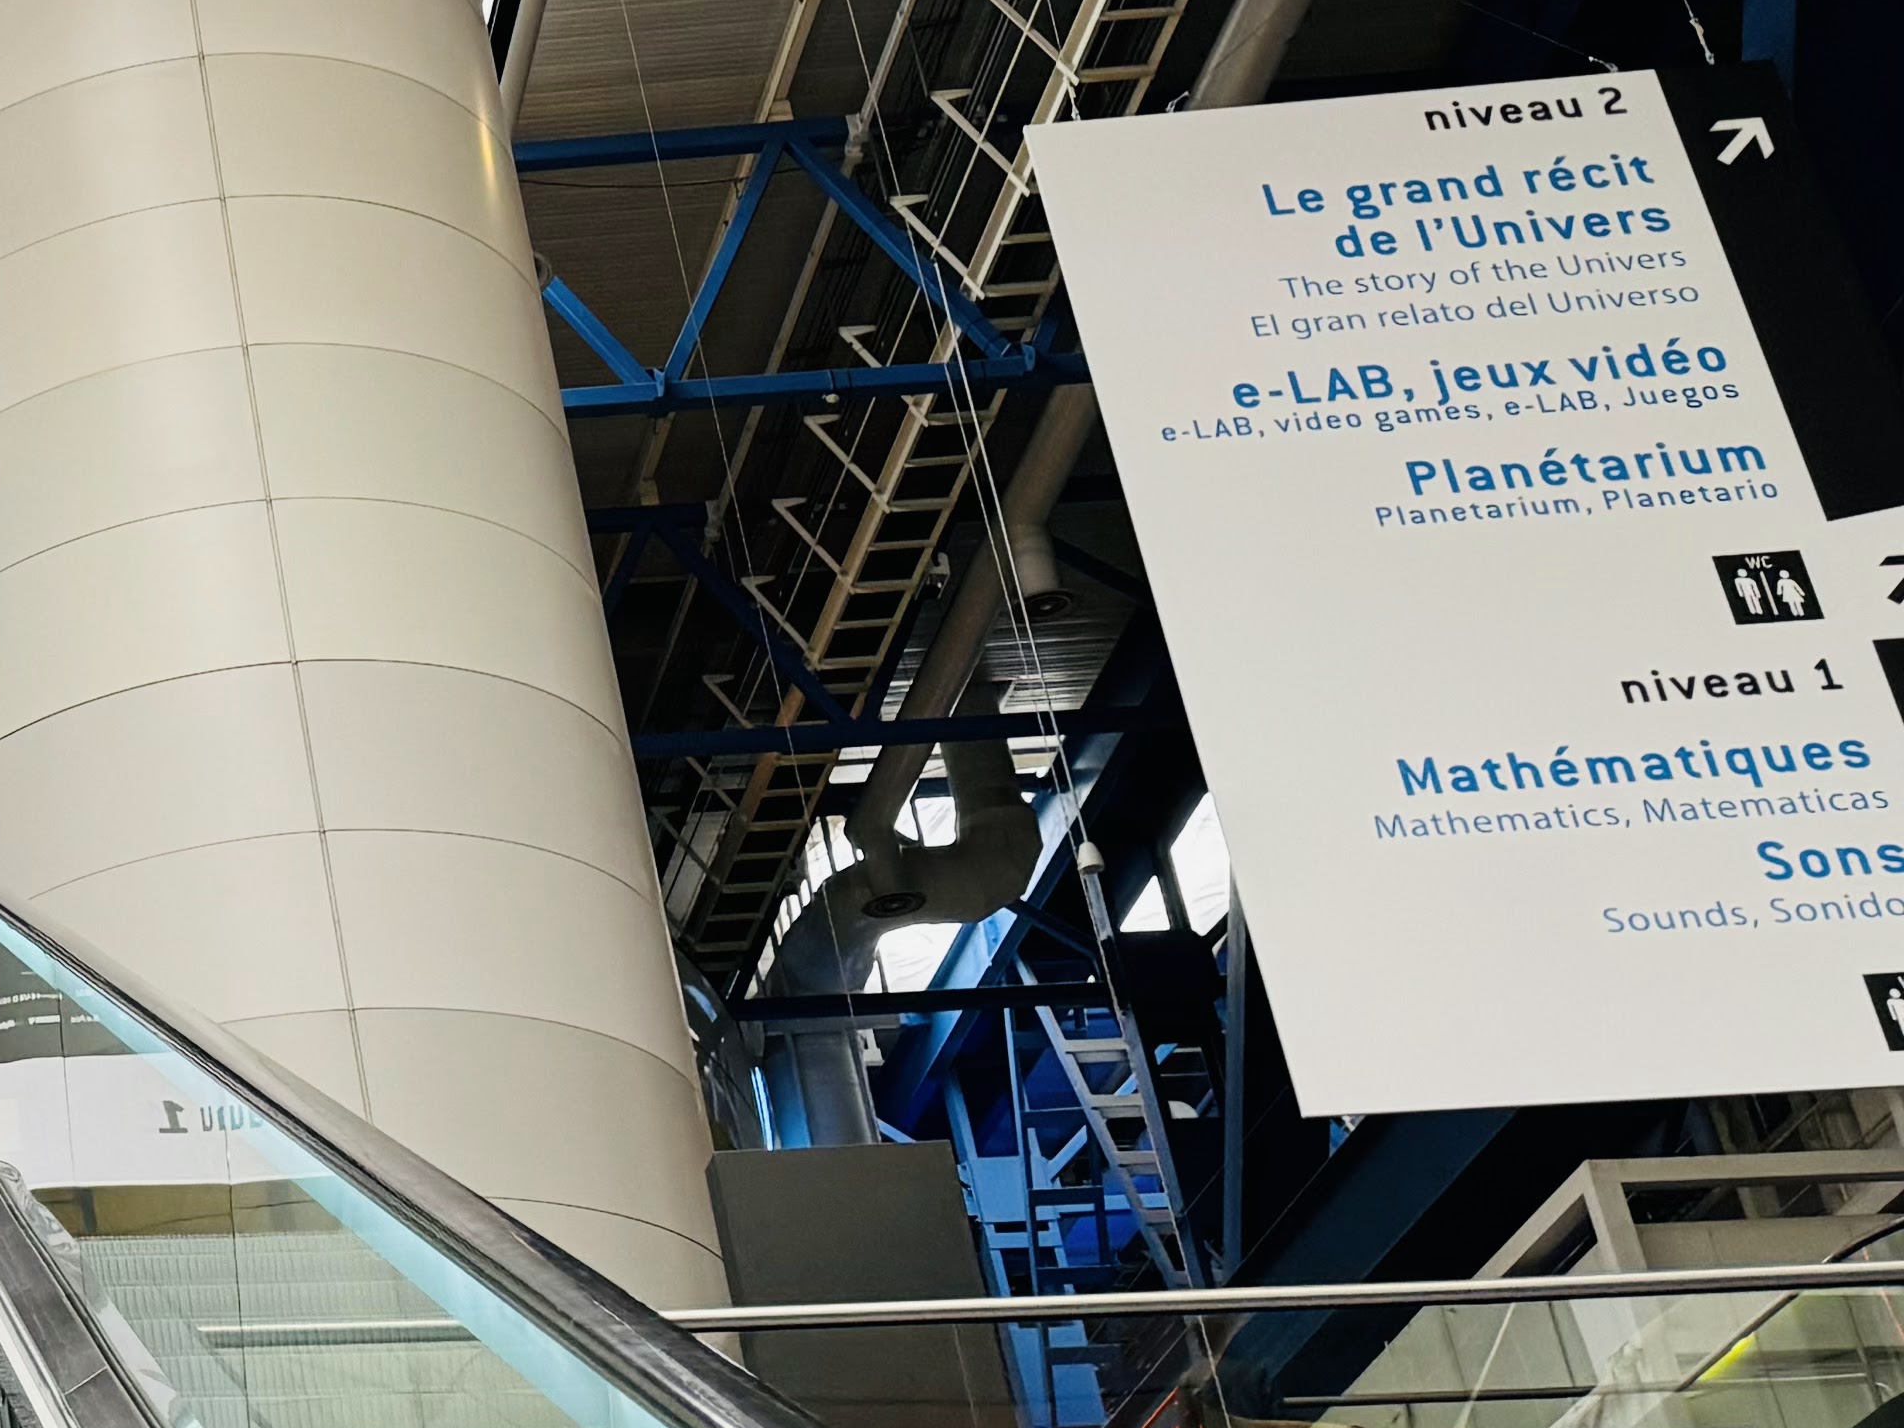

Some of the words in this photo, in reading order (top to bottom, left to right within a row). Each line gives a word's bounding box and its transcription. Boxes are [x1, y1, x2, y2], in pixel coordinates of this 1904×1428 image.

[1423, 97, 1584, 131] niveau
[1597, 86, 1628, 116] 2
[1261, 183, 1325, 216] Le
[1345, 164, 1505, 220] grand
[1522, 153, 1655, 195] récit
[1334, 224, 1398, 259] de
[1279, 275, 1343, 299] The
[1354, 272, 1436, 294] story
[1449, 261, 1480, 285] of
[1491, 259, 1548, 282] the
[1556, 250, 1687, 276] Univers
[1250, 314, 1280, 338] El
[1291, 314, 1366, 340] gran
[1378, 303, 1475, 328] relato
[1486, 292, 1538, 319] del
[1547, 286, 1699, 314] Universo
[1232, 364, 1415, 409] e-LAB,
[1429, 359, 1557, 407] jeux
[1567, 336, 1727, 383] vidéo
[1161, 416, 1265, 442] e-LAB,
[1273, 411, 1362, 433] video
[1374, 404, 1493, 433] games,
[1504, 390, 1611, 416] e-LAB,
[1623, 383, 1740, 409] Juegos
[1405, 441, 1767, 496] Planétarium
[1375, 498, 1592, 527] Planetarium,
[1602, 479, 1778, 510] Planetario
[1745, 555, 1773, 570] WC
[1620, 669, 1795, 704] niveau
[1813, 658, 1844, 691] 1
[1396, 739, 1871, 797] Mathématiques
[1374, 804, 1630, 839] Mathematics,
[1642, 788, 1889, 823] Matematicas
[1757, 840, 1904, 880] Sons
[1603, 901, 1758, 933] Sounds,
